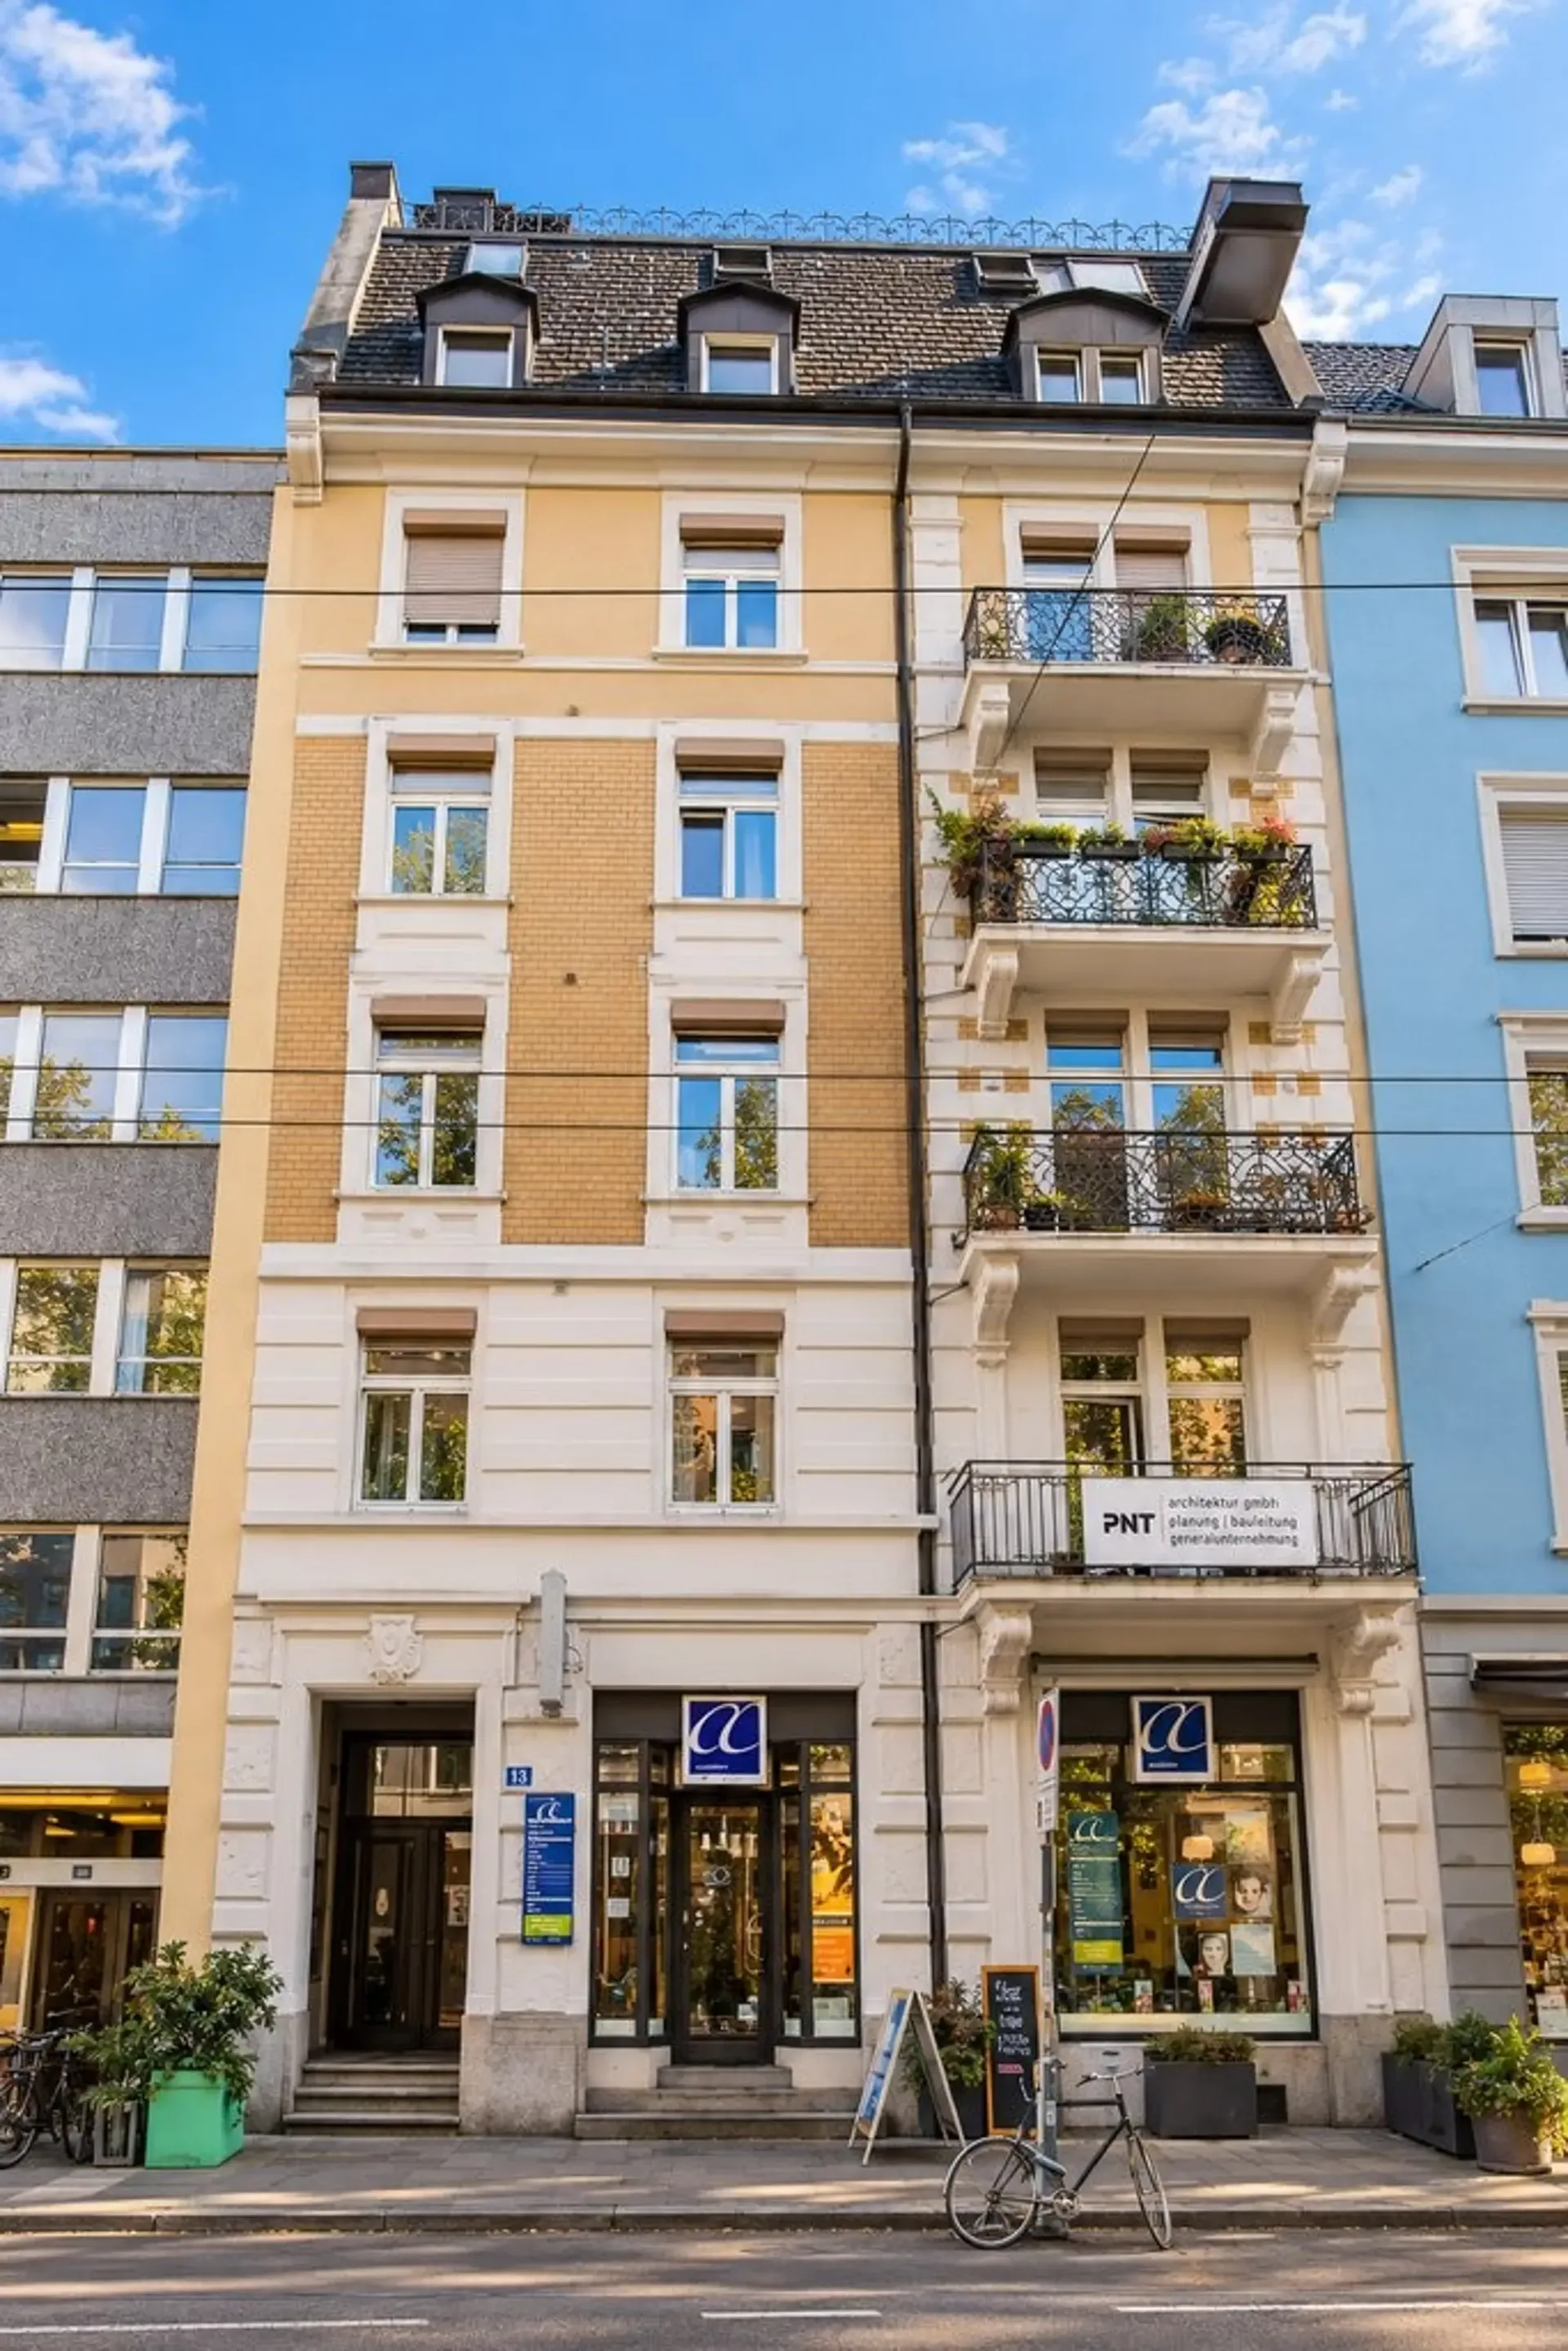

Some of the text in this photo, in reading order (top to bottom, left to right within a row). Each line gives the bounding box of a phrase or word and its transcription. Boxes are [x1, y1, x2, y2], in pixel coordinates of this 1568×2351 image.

[1168, 1496, 1281, 1511] architektur gmbh
[1103, 1513, 1156, 1534] PNT
[1168, 1515, 1298, 1530] planung bauleitung
[1169, 1532, 1299, 1548] generalunternehmung
[510, 1769, 528, 1785] 13
